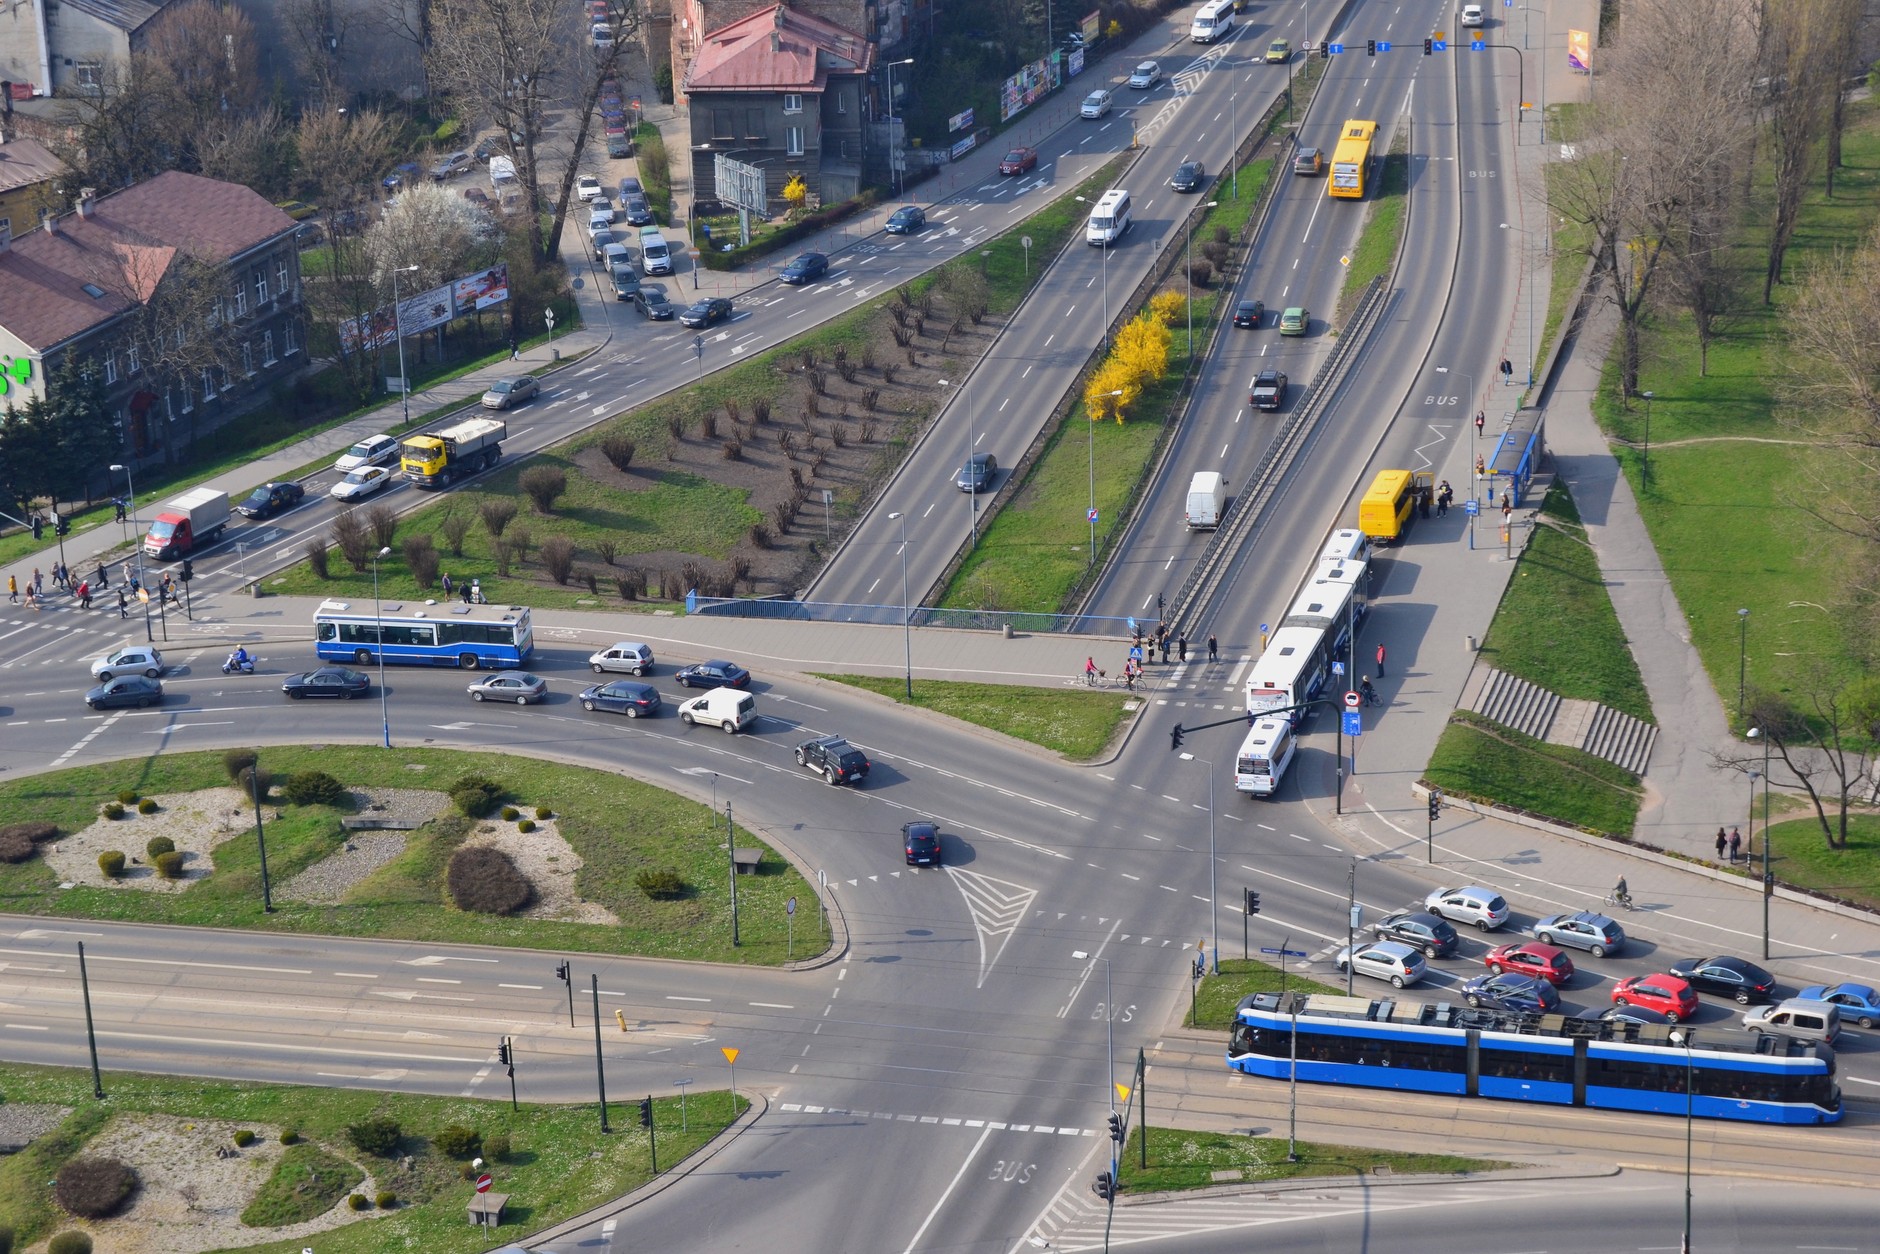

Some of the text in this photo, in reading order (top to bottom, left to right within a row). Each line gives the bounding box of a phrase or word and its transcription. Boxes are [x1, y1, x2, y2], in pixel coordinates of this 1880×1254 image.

[1469, 170, 1496, 178] BUS
[948, 198, 979, 206] BUS
[852, 244, 885, 254] BUS
[734, 296, 769, 306] BUS
[1424, 395, 1459, 406] BUS
[1091, 1002, 1138, 1023] BUS
[988, 1160, 1037, 1184] BUS
